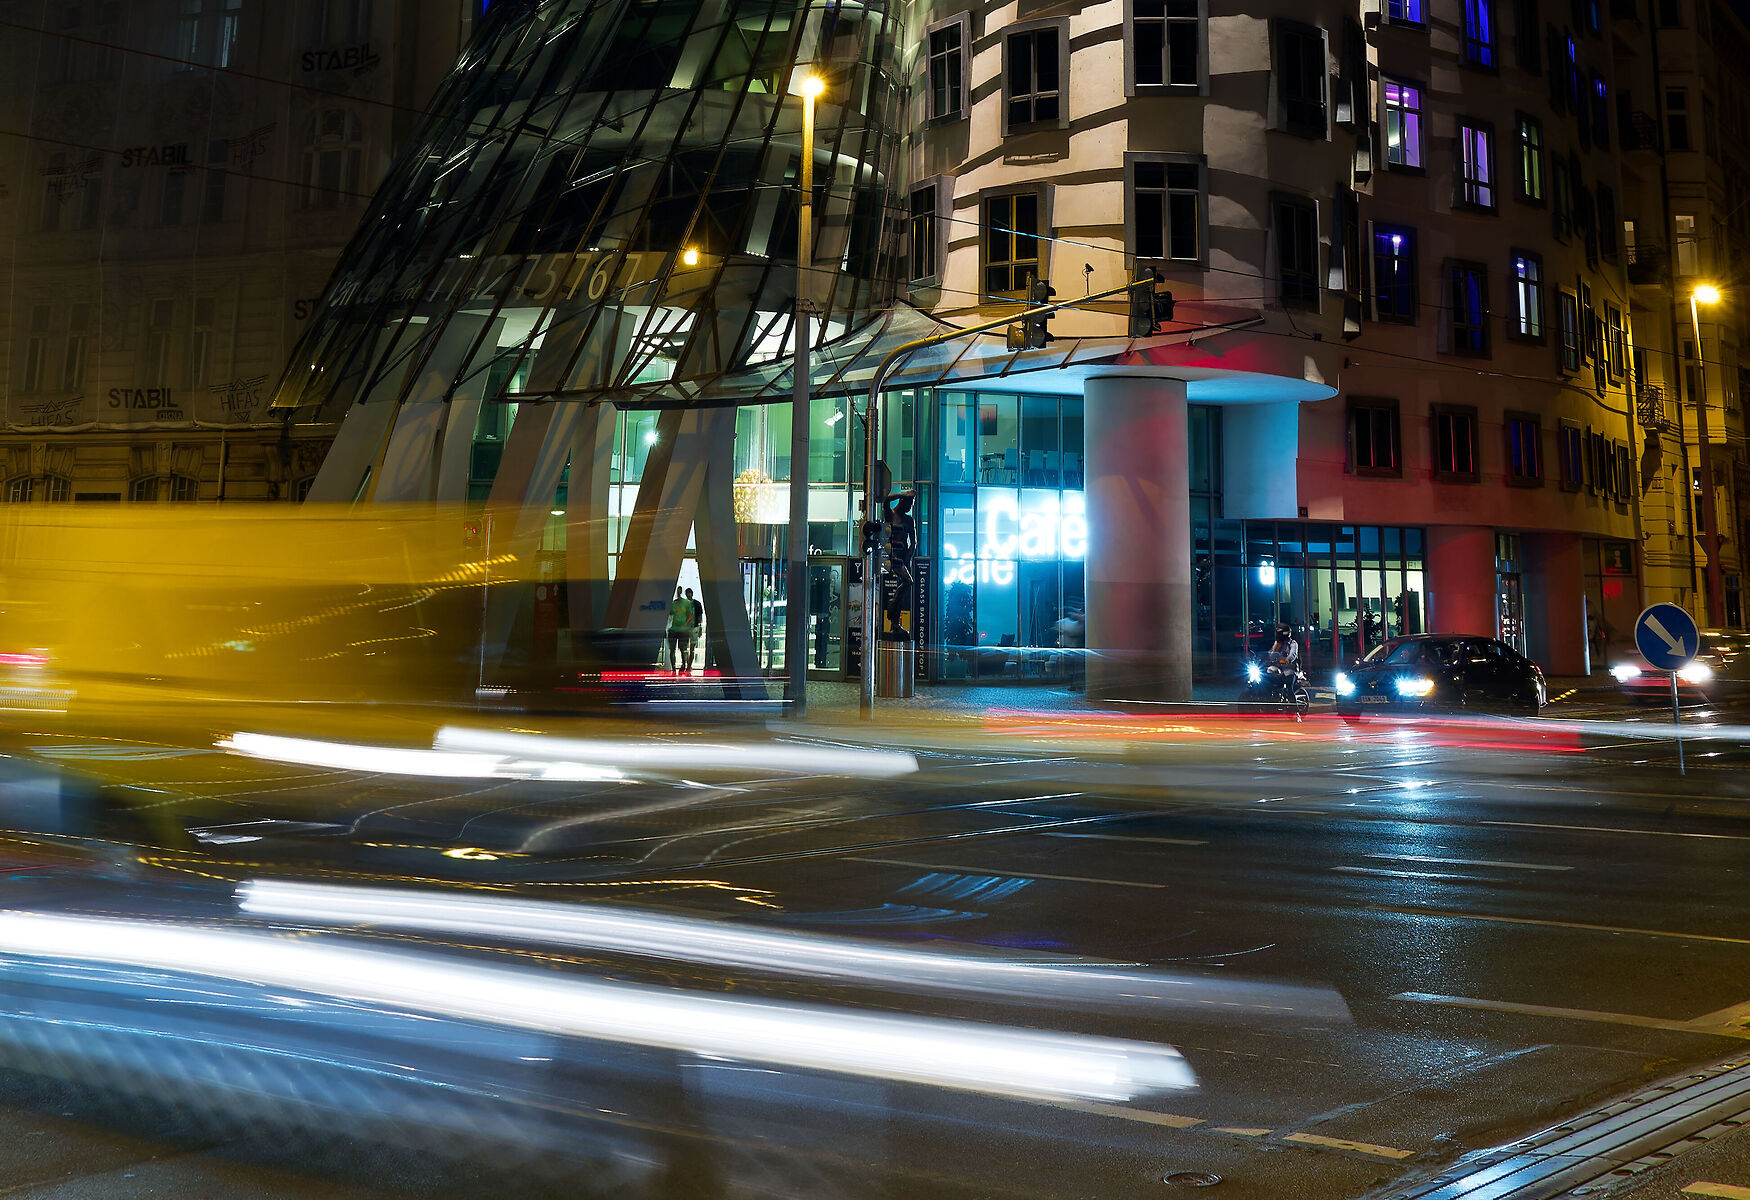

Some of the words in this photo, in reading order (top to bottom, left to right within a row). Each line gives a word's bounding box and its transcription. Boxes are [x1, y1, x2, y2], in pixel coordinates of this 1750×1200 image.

[302, 43, 379, 72] STABIL
[121, 143, 192, 167] STABIL
[108, 388, 178, 409] STABIL
